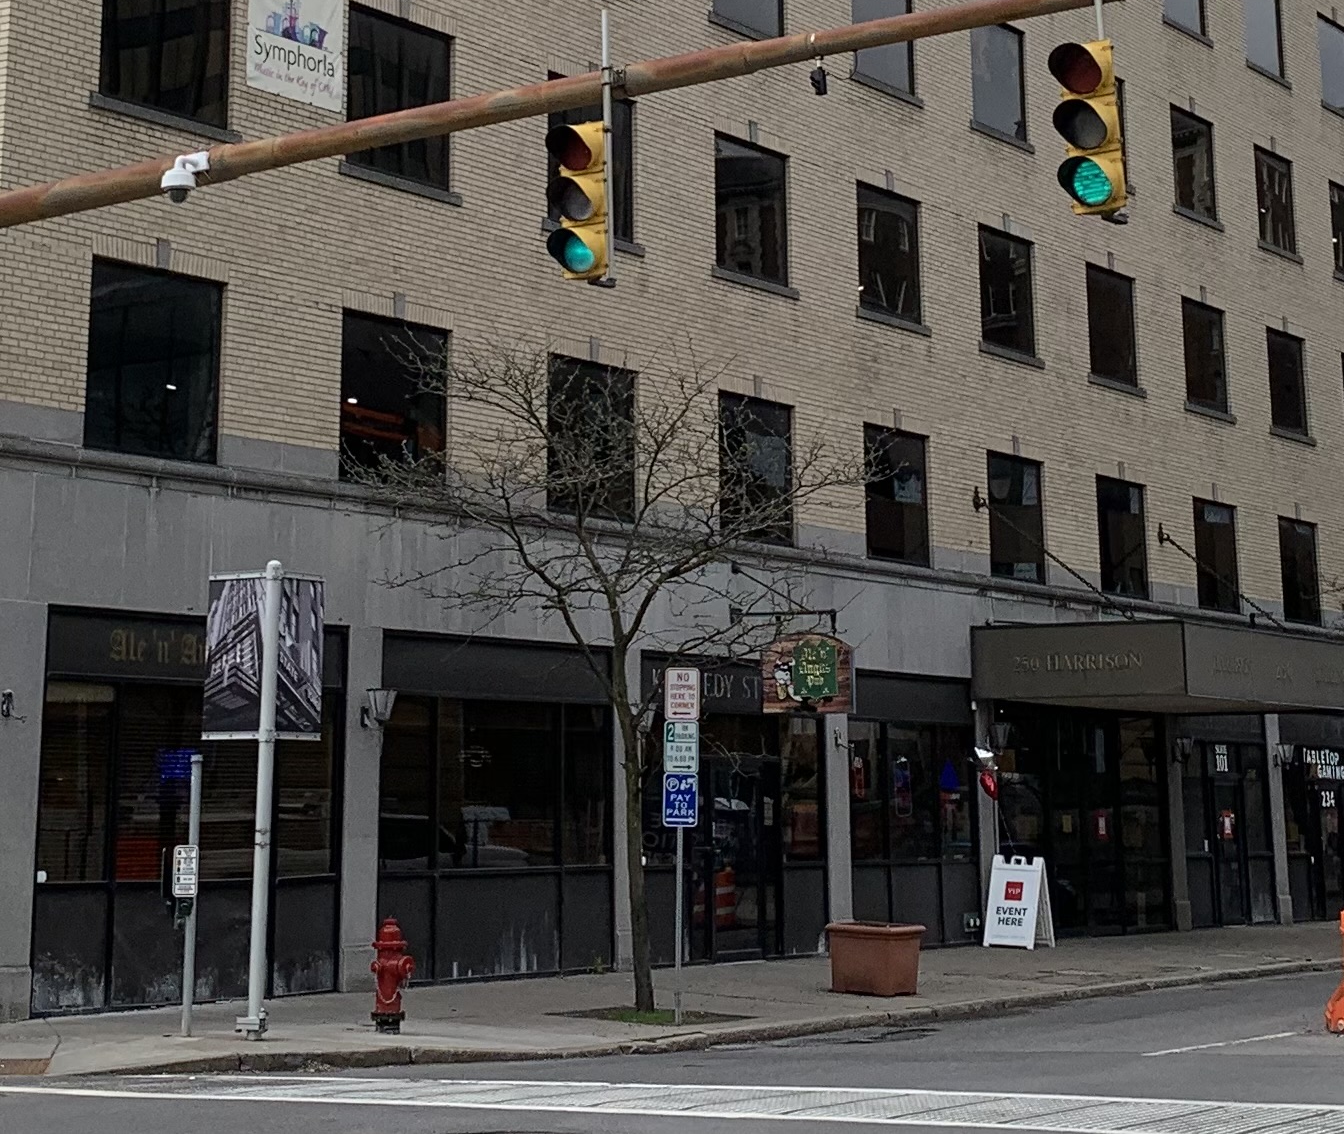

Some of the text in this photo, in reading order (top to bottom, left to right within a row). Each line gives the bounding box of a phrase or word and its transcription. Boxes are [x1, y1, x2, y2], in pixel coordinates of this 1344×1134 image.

[1047, 652, 1142, 671] HARRISON
[798, 661, 831, 676] Angus
[677, 672, 690, 682] NO
[806, 675, 824, 688] Pub
[670, 692, 685, 700] HERE
[667, 724, 675, 740] 2
[1302, 747, 1340, 766] TABLETOP
[1216, 754, 1229, 772] 101
[670, 794, 691, 802] PAY
[1320, 791, 1336, 807] 234
[674, 801, 688, 809] TO
[666, 808, 695, 816] PARK
[1007, 887, 1021, 895] VIP
[995, 906, 1028, 916] EVENT
[997, 917, 1024, 926] HERE
